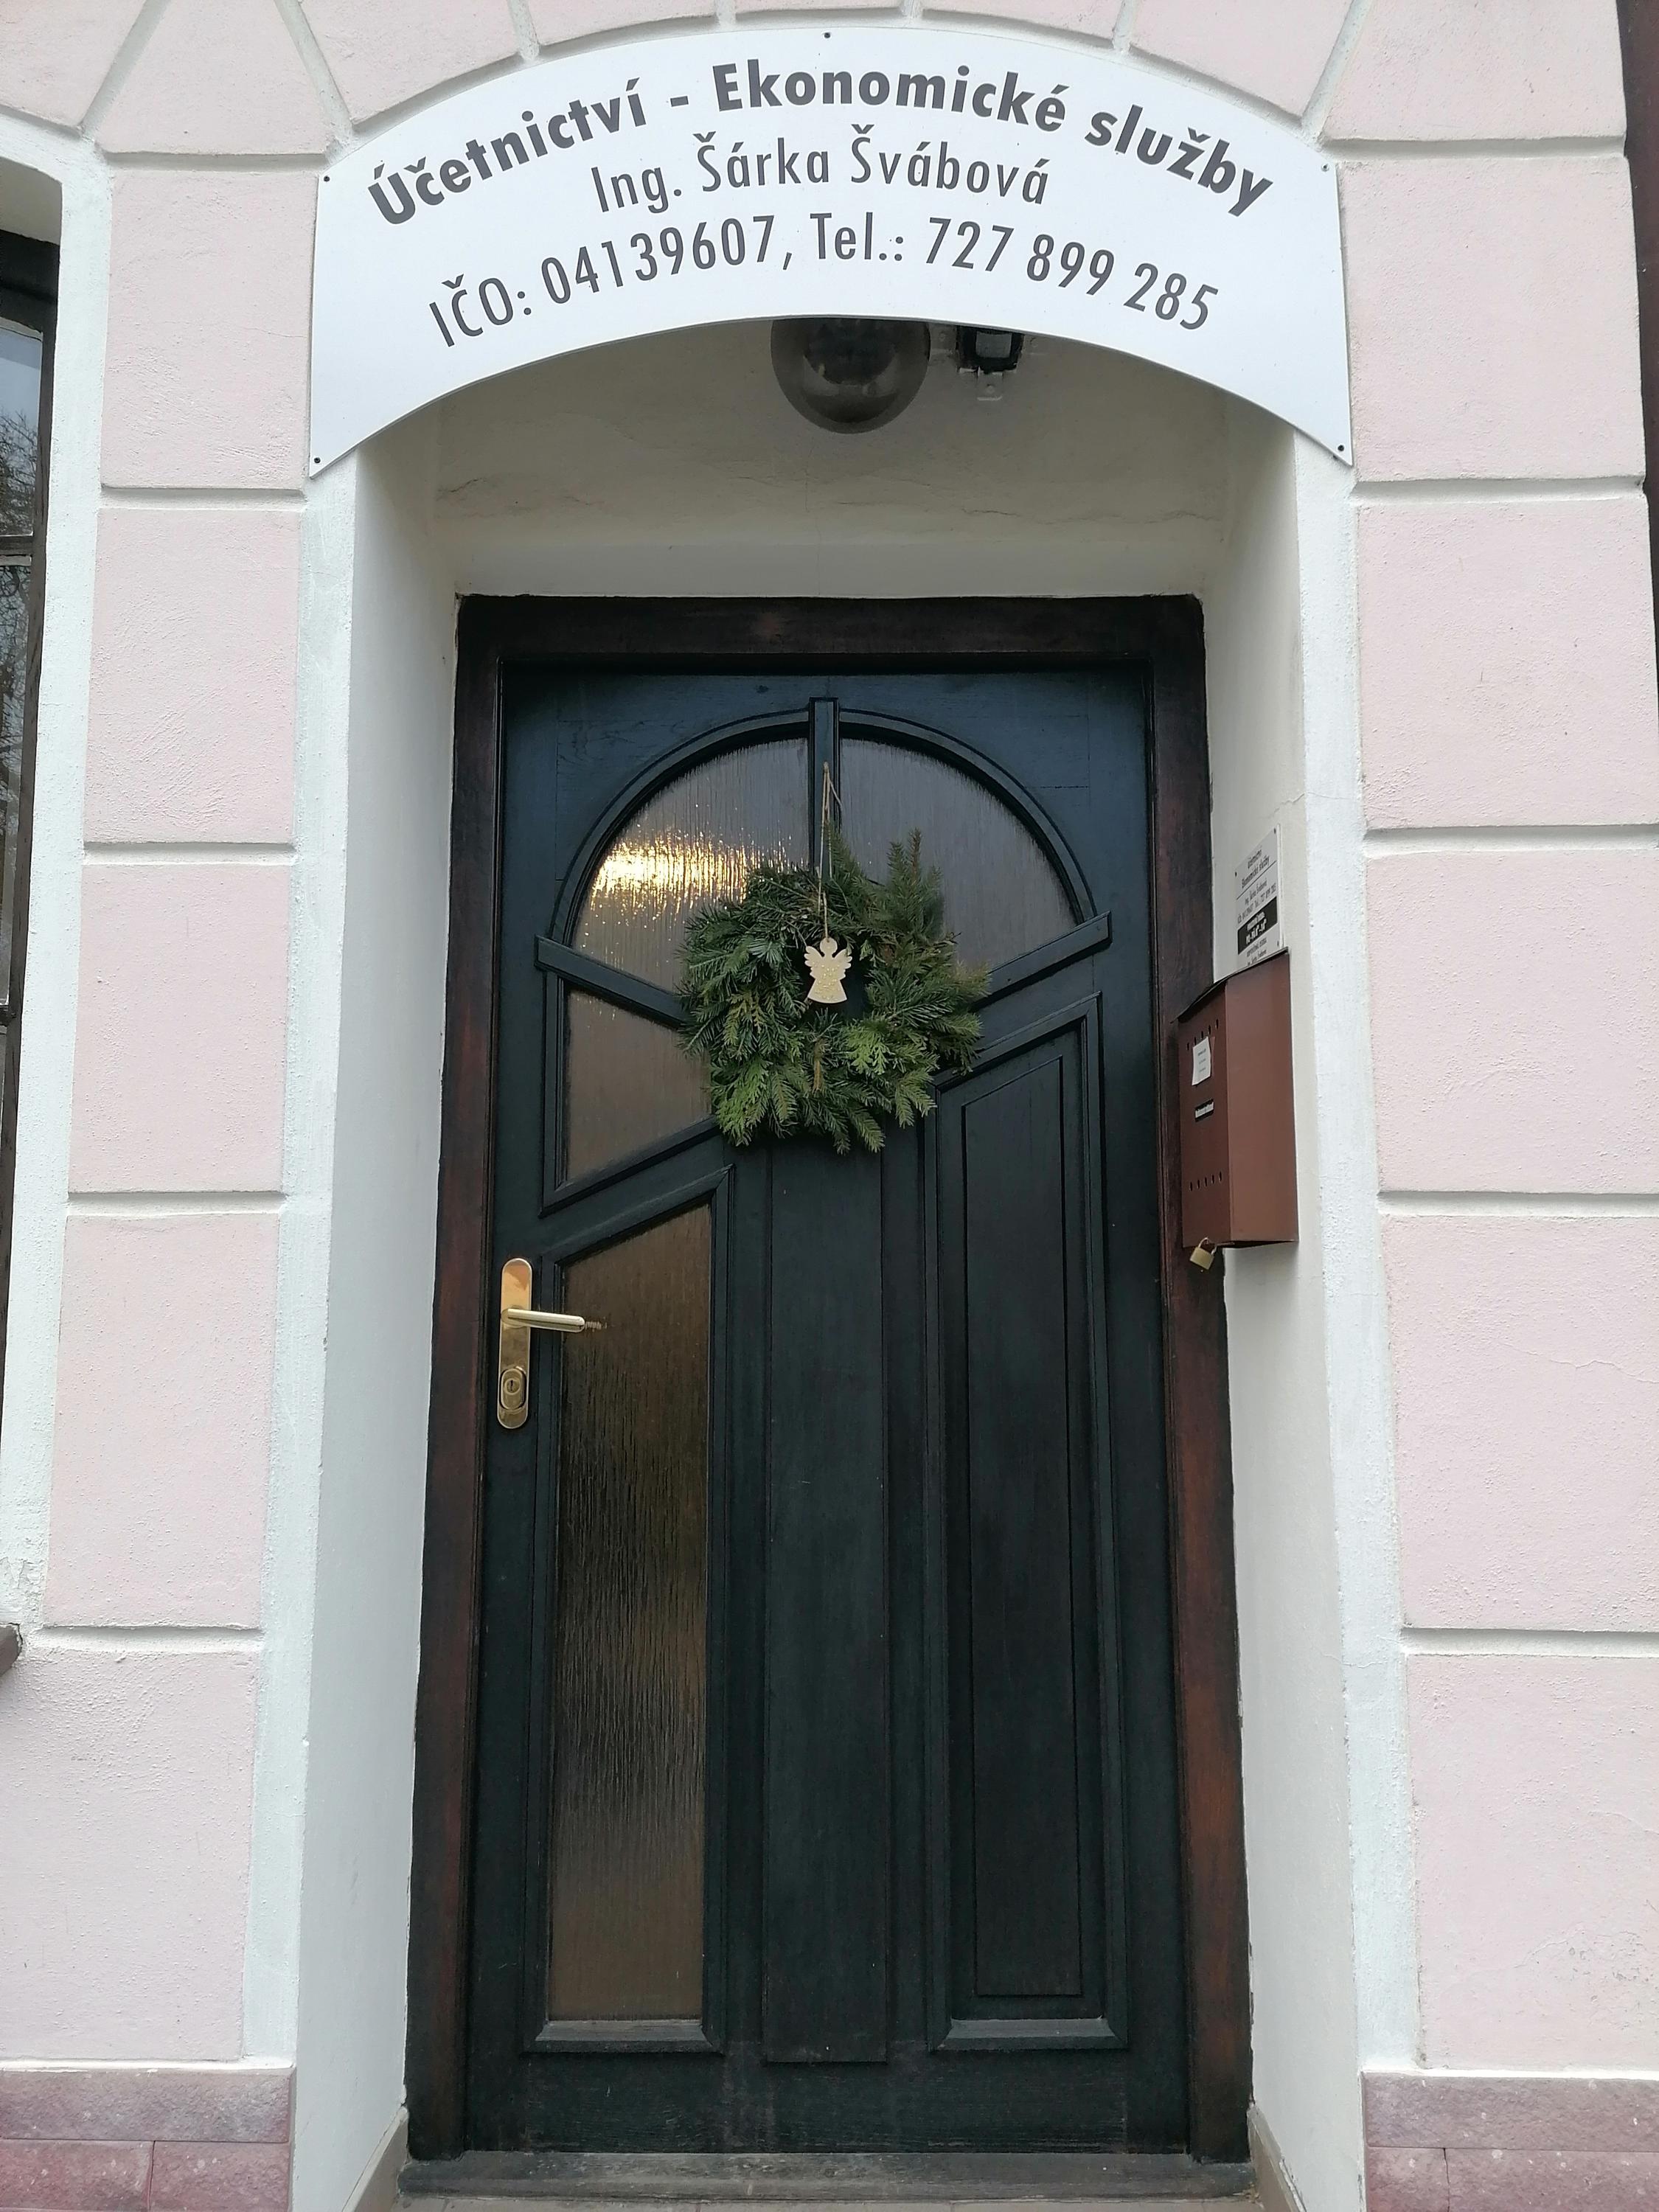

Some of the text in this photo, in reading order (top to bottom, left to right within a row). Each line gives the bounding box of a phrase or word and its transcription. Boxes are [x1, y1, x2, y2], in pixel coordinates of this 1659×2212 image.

[368, 58, 1273, 225] Účetnictví - Ekonomické služby
[591, 124, 1050, 214] Ing. Šárka Švábová
[428, 212, 1219, 347] IČO: 04139607, Tel.: 727 899 285
